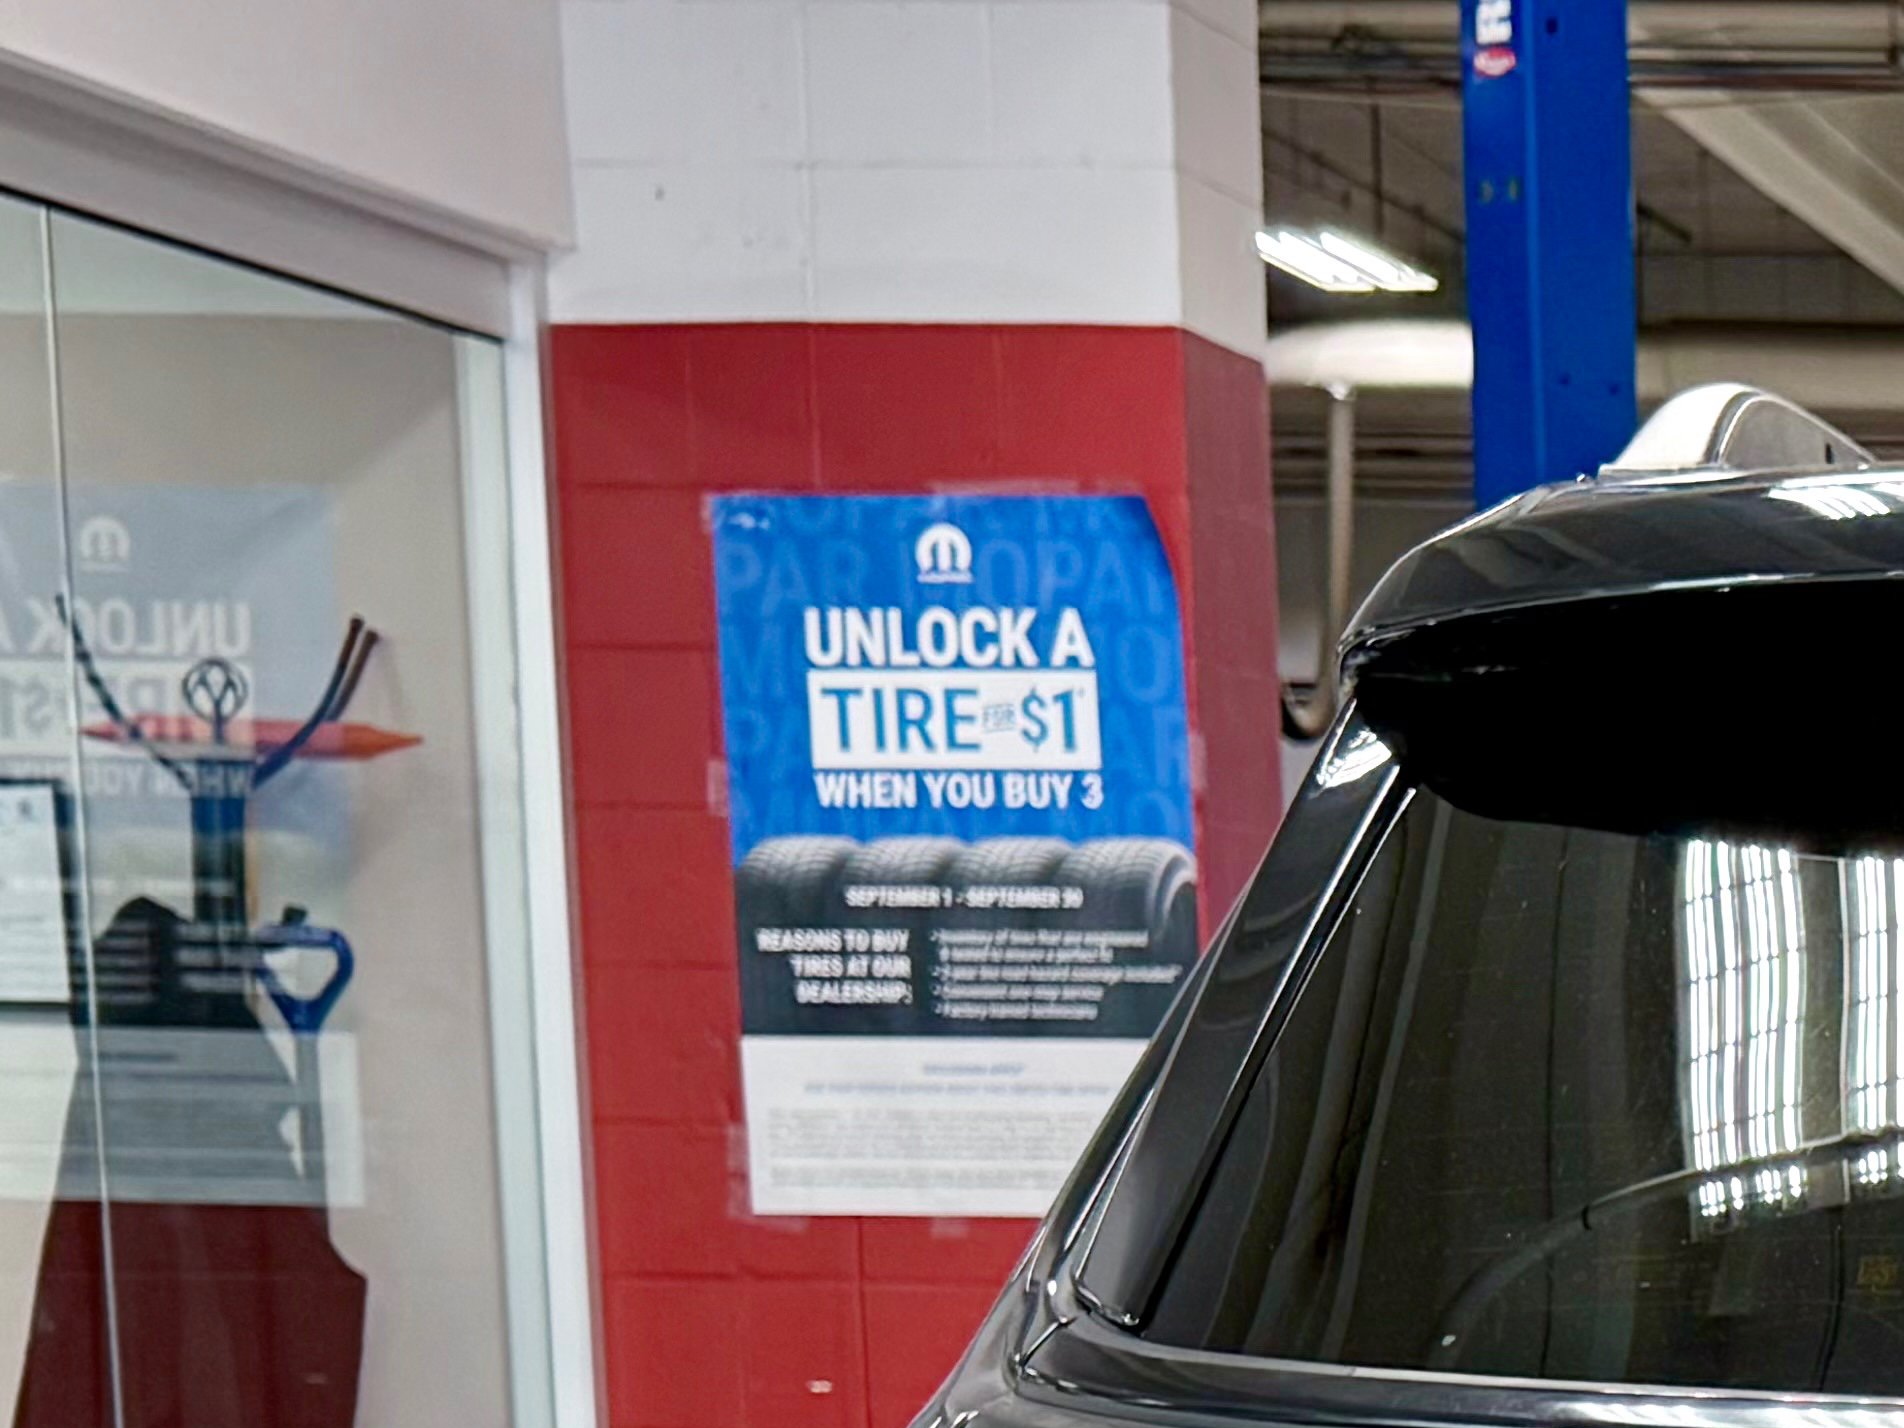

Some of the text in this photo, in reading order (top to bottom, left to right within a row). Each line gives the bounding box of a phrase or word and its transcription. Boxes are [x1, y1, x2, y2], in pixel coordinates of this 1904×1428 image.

[804, 606, 1040, 668] UNLOCK
[1051, 606, 1095, 668] A
[821, 687, 981, 753] TIRE
[814, 773, 1105, 810] WHEN YOU BUY 3
[844, 884, 940, 908] SEPTEMBER
[966, 884, 1061, 909] SEPTEMBER
[755, 927, 843, 952] REASONS
[844, 927, 870, 952] TO
[871, 927, 910, 952] BUY
[788, 953, 844, 978] TIRES
[845, 953, 870, 978] AT
[871, 953, 912, 979] OUR
